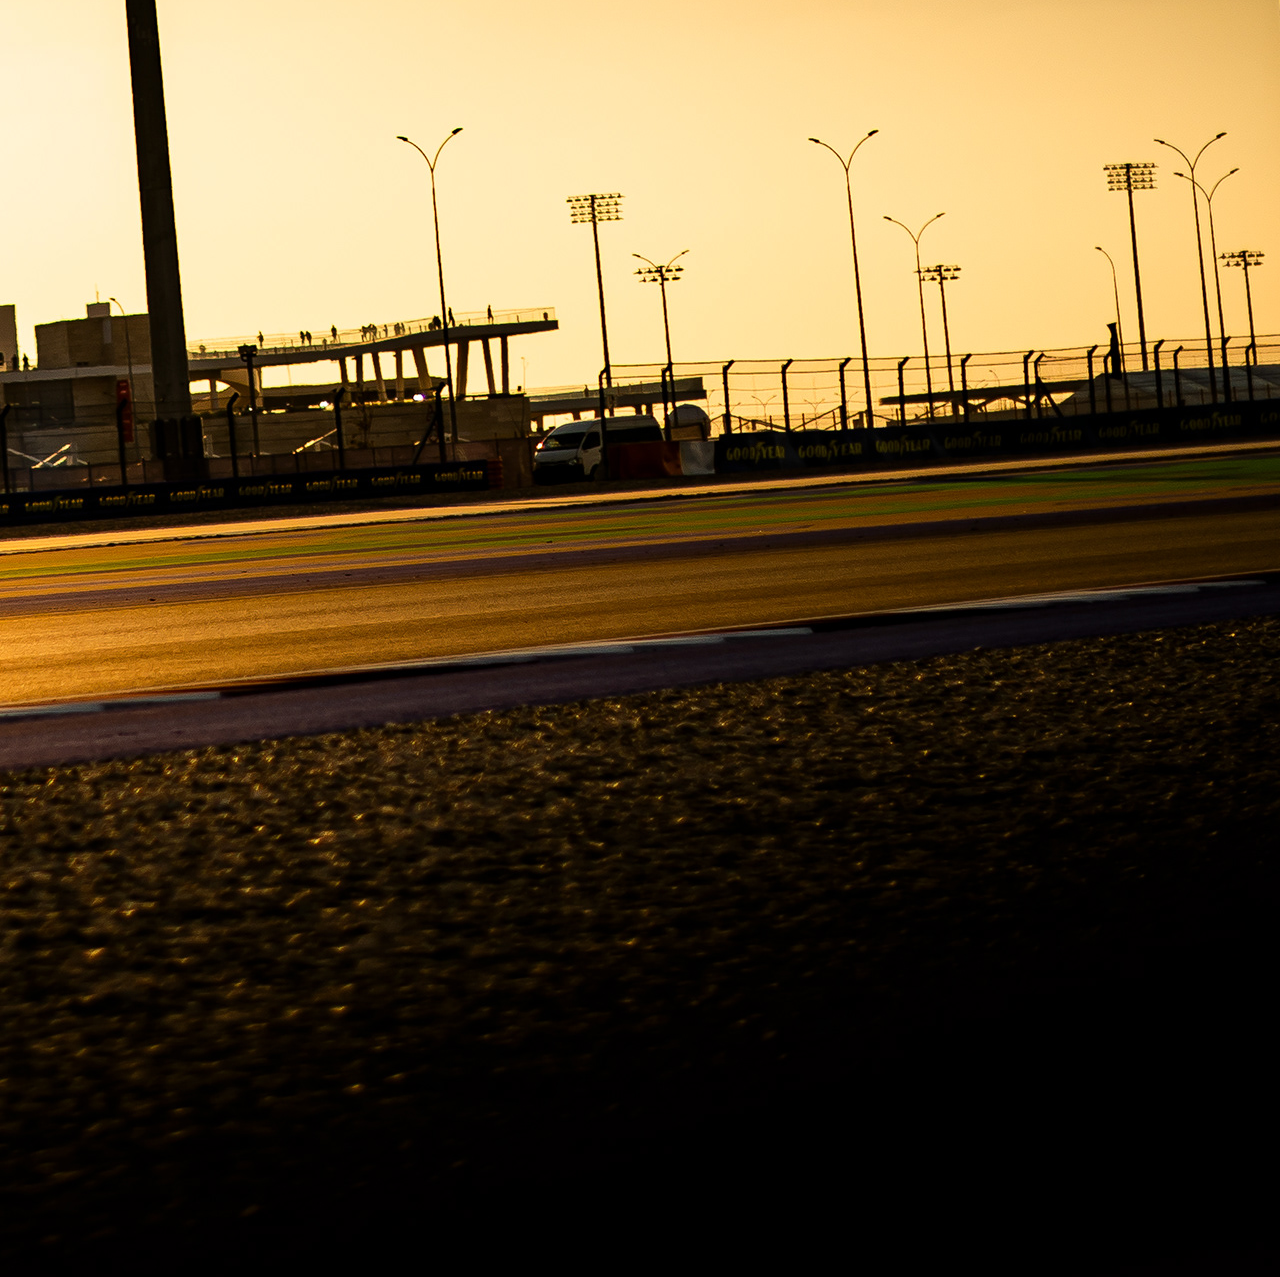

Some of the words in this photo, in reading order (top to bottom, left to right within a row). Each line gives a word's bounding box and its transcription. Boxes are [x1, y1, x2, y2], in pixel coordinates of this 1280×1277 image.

[798, 439, 863, 461] GOODYEAR
[875, 434, 932, 457] GOODYEAR
[305, 475, 358, 492] GOODYEAR
[371, 472, 422, 489] GOODYEAR
[435, 467, 484, 484] GOODYEAR
[170, 485, 225, 502] GOODYEAR
[238, 480, 292, 498] GOODYEAR
[24, 495, 84, 513] GOODYEAR
[98, 490, 156, 508] GOODYEAR
